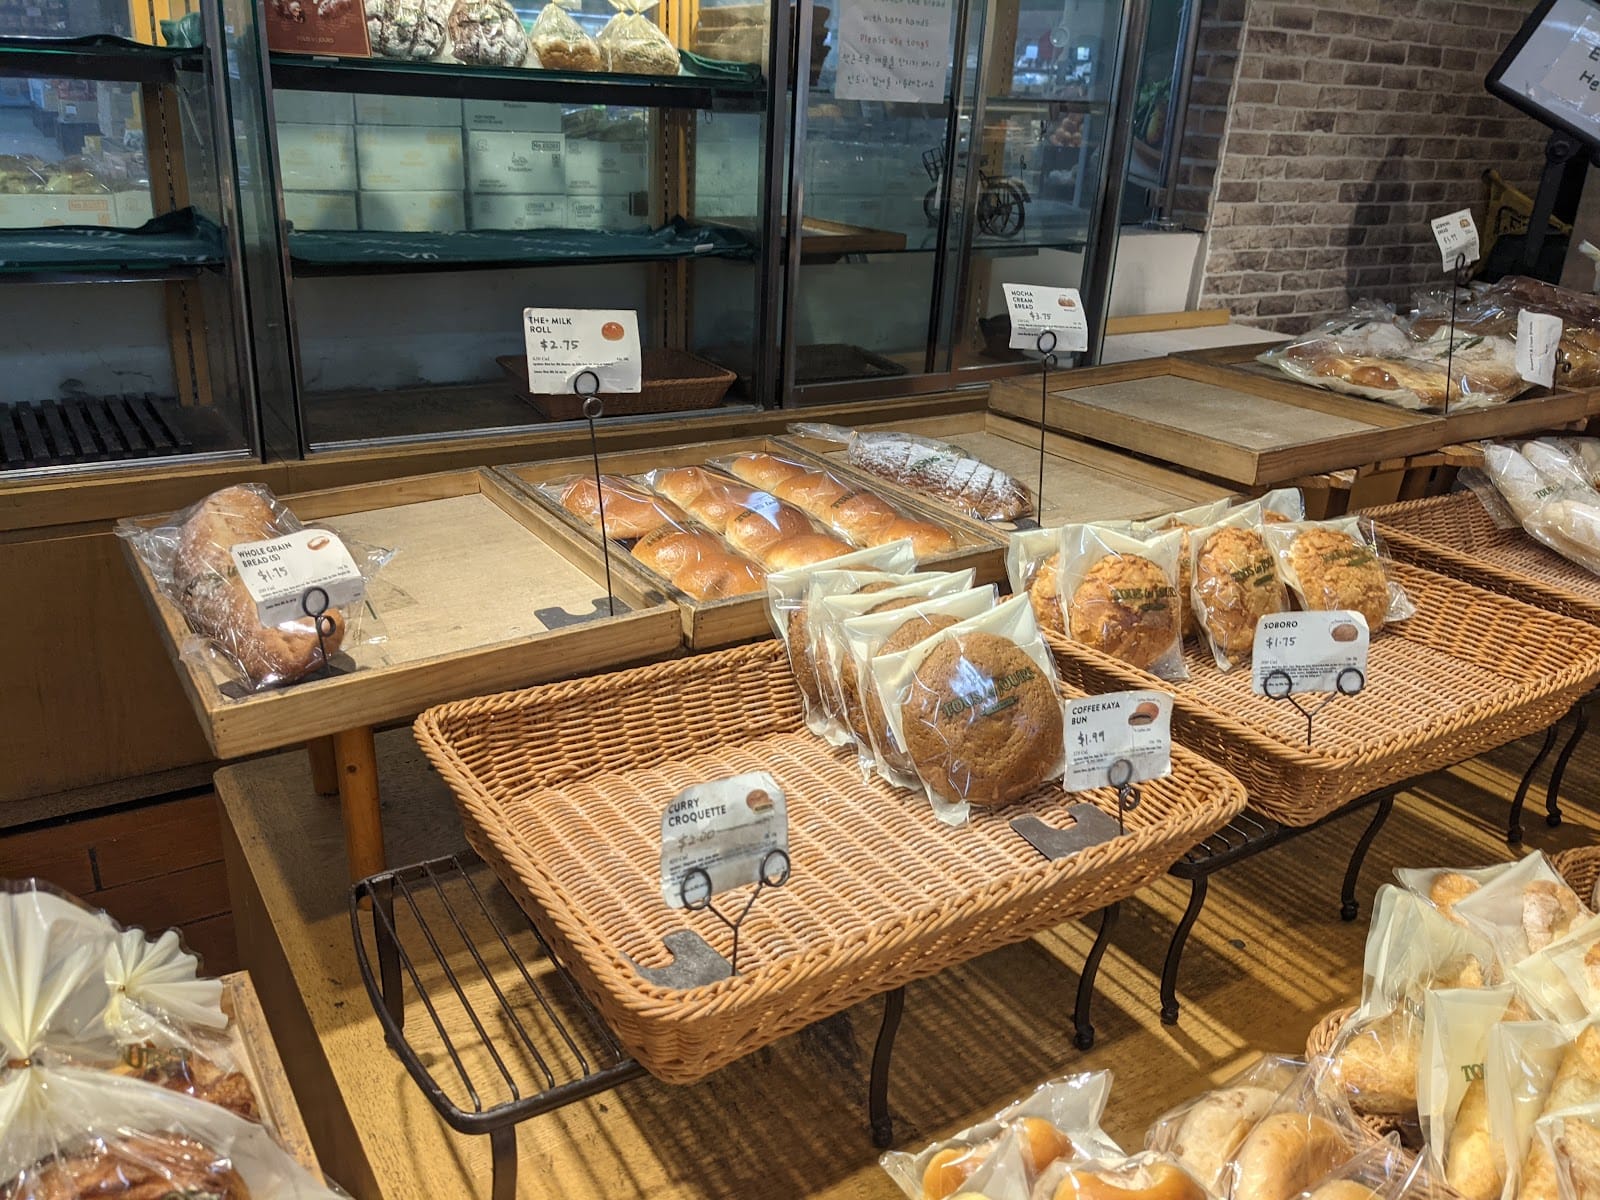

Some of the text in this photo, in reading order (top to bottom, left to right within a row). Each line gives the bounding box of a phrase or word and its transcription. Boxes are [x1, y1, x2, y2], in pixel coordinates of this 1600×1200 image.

[863, 13, 881, 22] with
[905, 16, 929, 27] hands
[860, 33, 886, 45] Please
[907, 38, 929, 50] tongs
[551, 317, 572, 325] MILK
[1029, 311, 1052, 321] $3.75
[529, 326, 552, 334] ROLL
[540, 338, 580, 351] $2.75
[237, 542, 292, 559] WHOLE GRAIN
[242, 553, 281, 568] BREAD (S)
[257, 566, 288, 583] $1.75
[1263, 620, 1298, 630] SOBORO
[1265, 636, 1297, 649] $1.75
[1072, 701, 1120, 715] COFFEE KAYA
[1071, 716, 1087, 725] BUN
[1077, 730, 1105, 747] $1.99
[668, 798, 699, 815] CURRY
[668, 804, 727, 827] CROQUETTE
